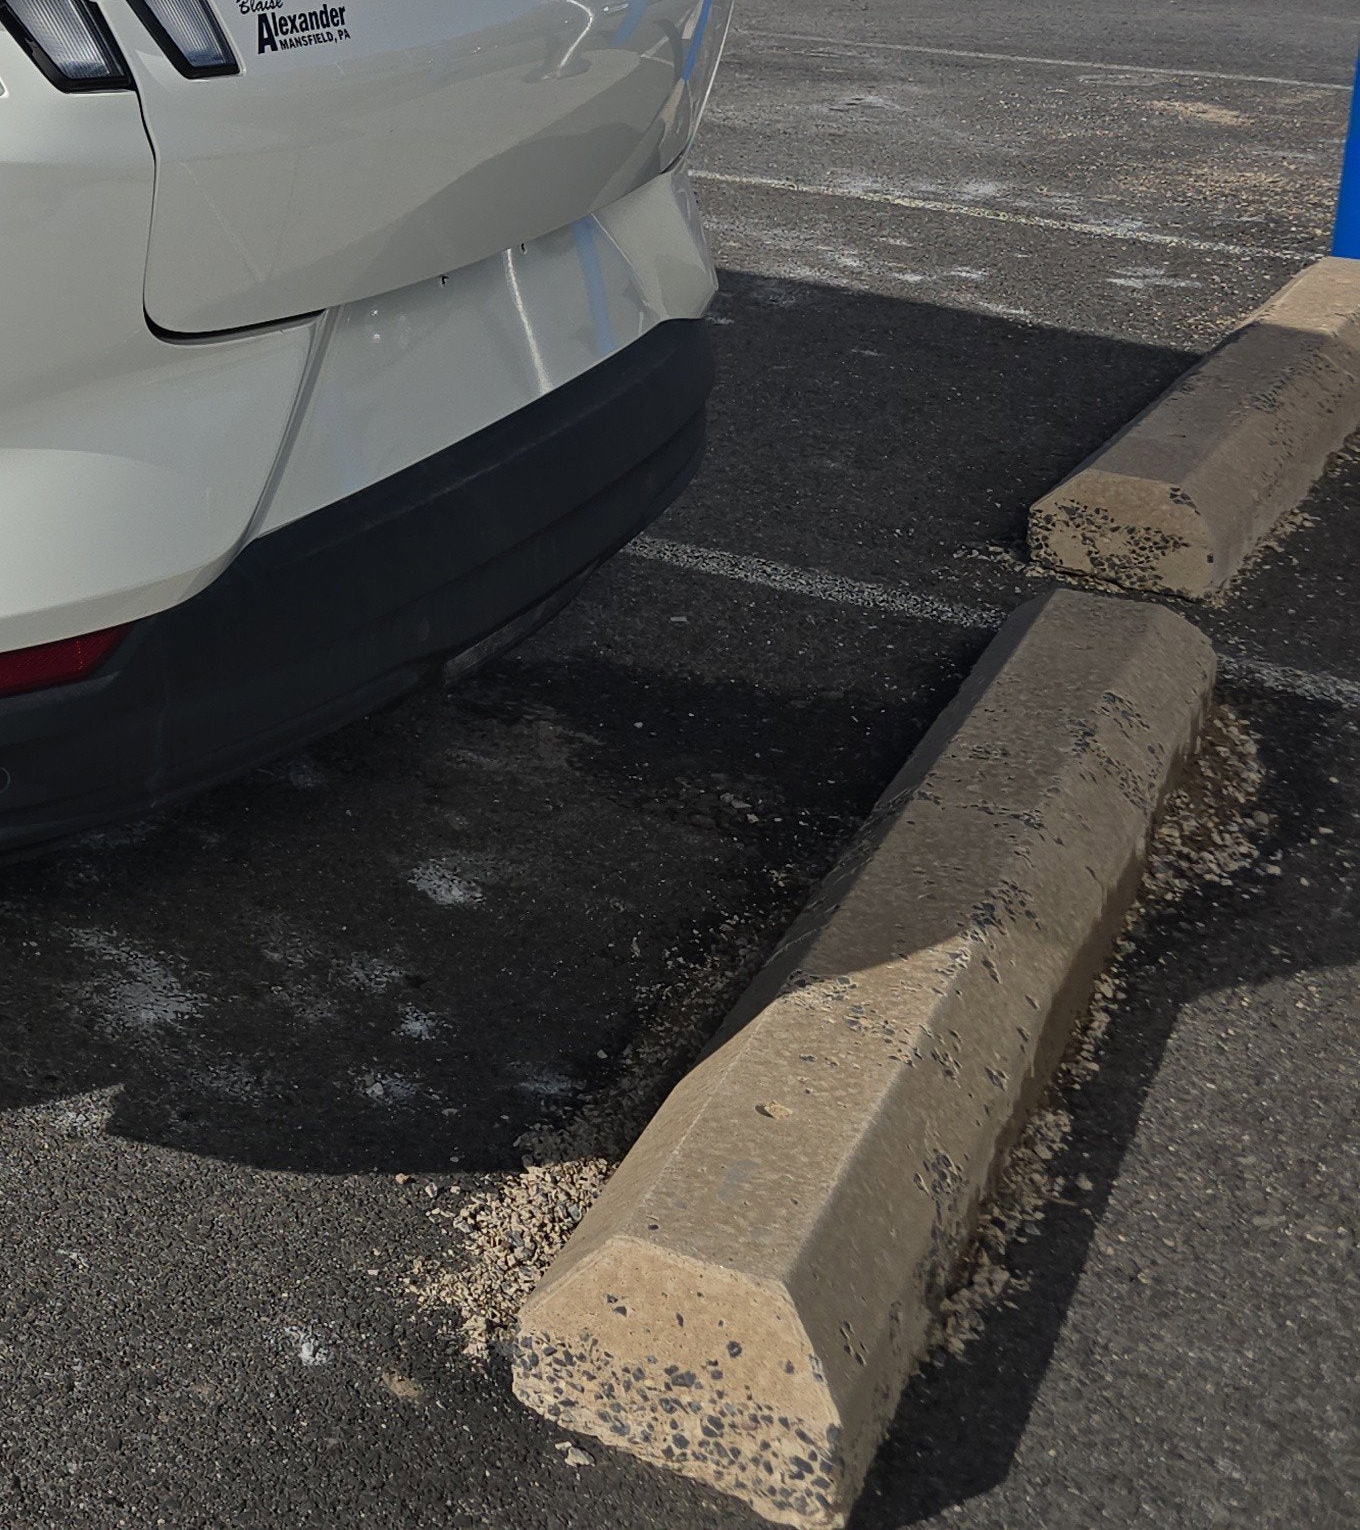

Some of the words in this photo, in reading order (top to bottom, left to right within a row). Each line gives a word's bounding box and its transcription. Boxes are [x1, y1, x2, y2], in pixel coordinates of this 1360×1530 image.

[257, 3, 346, 54] Alexander
[279, 31, 338, 51] MANSFIELD,
[337, 28, 351, 41] PA
